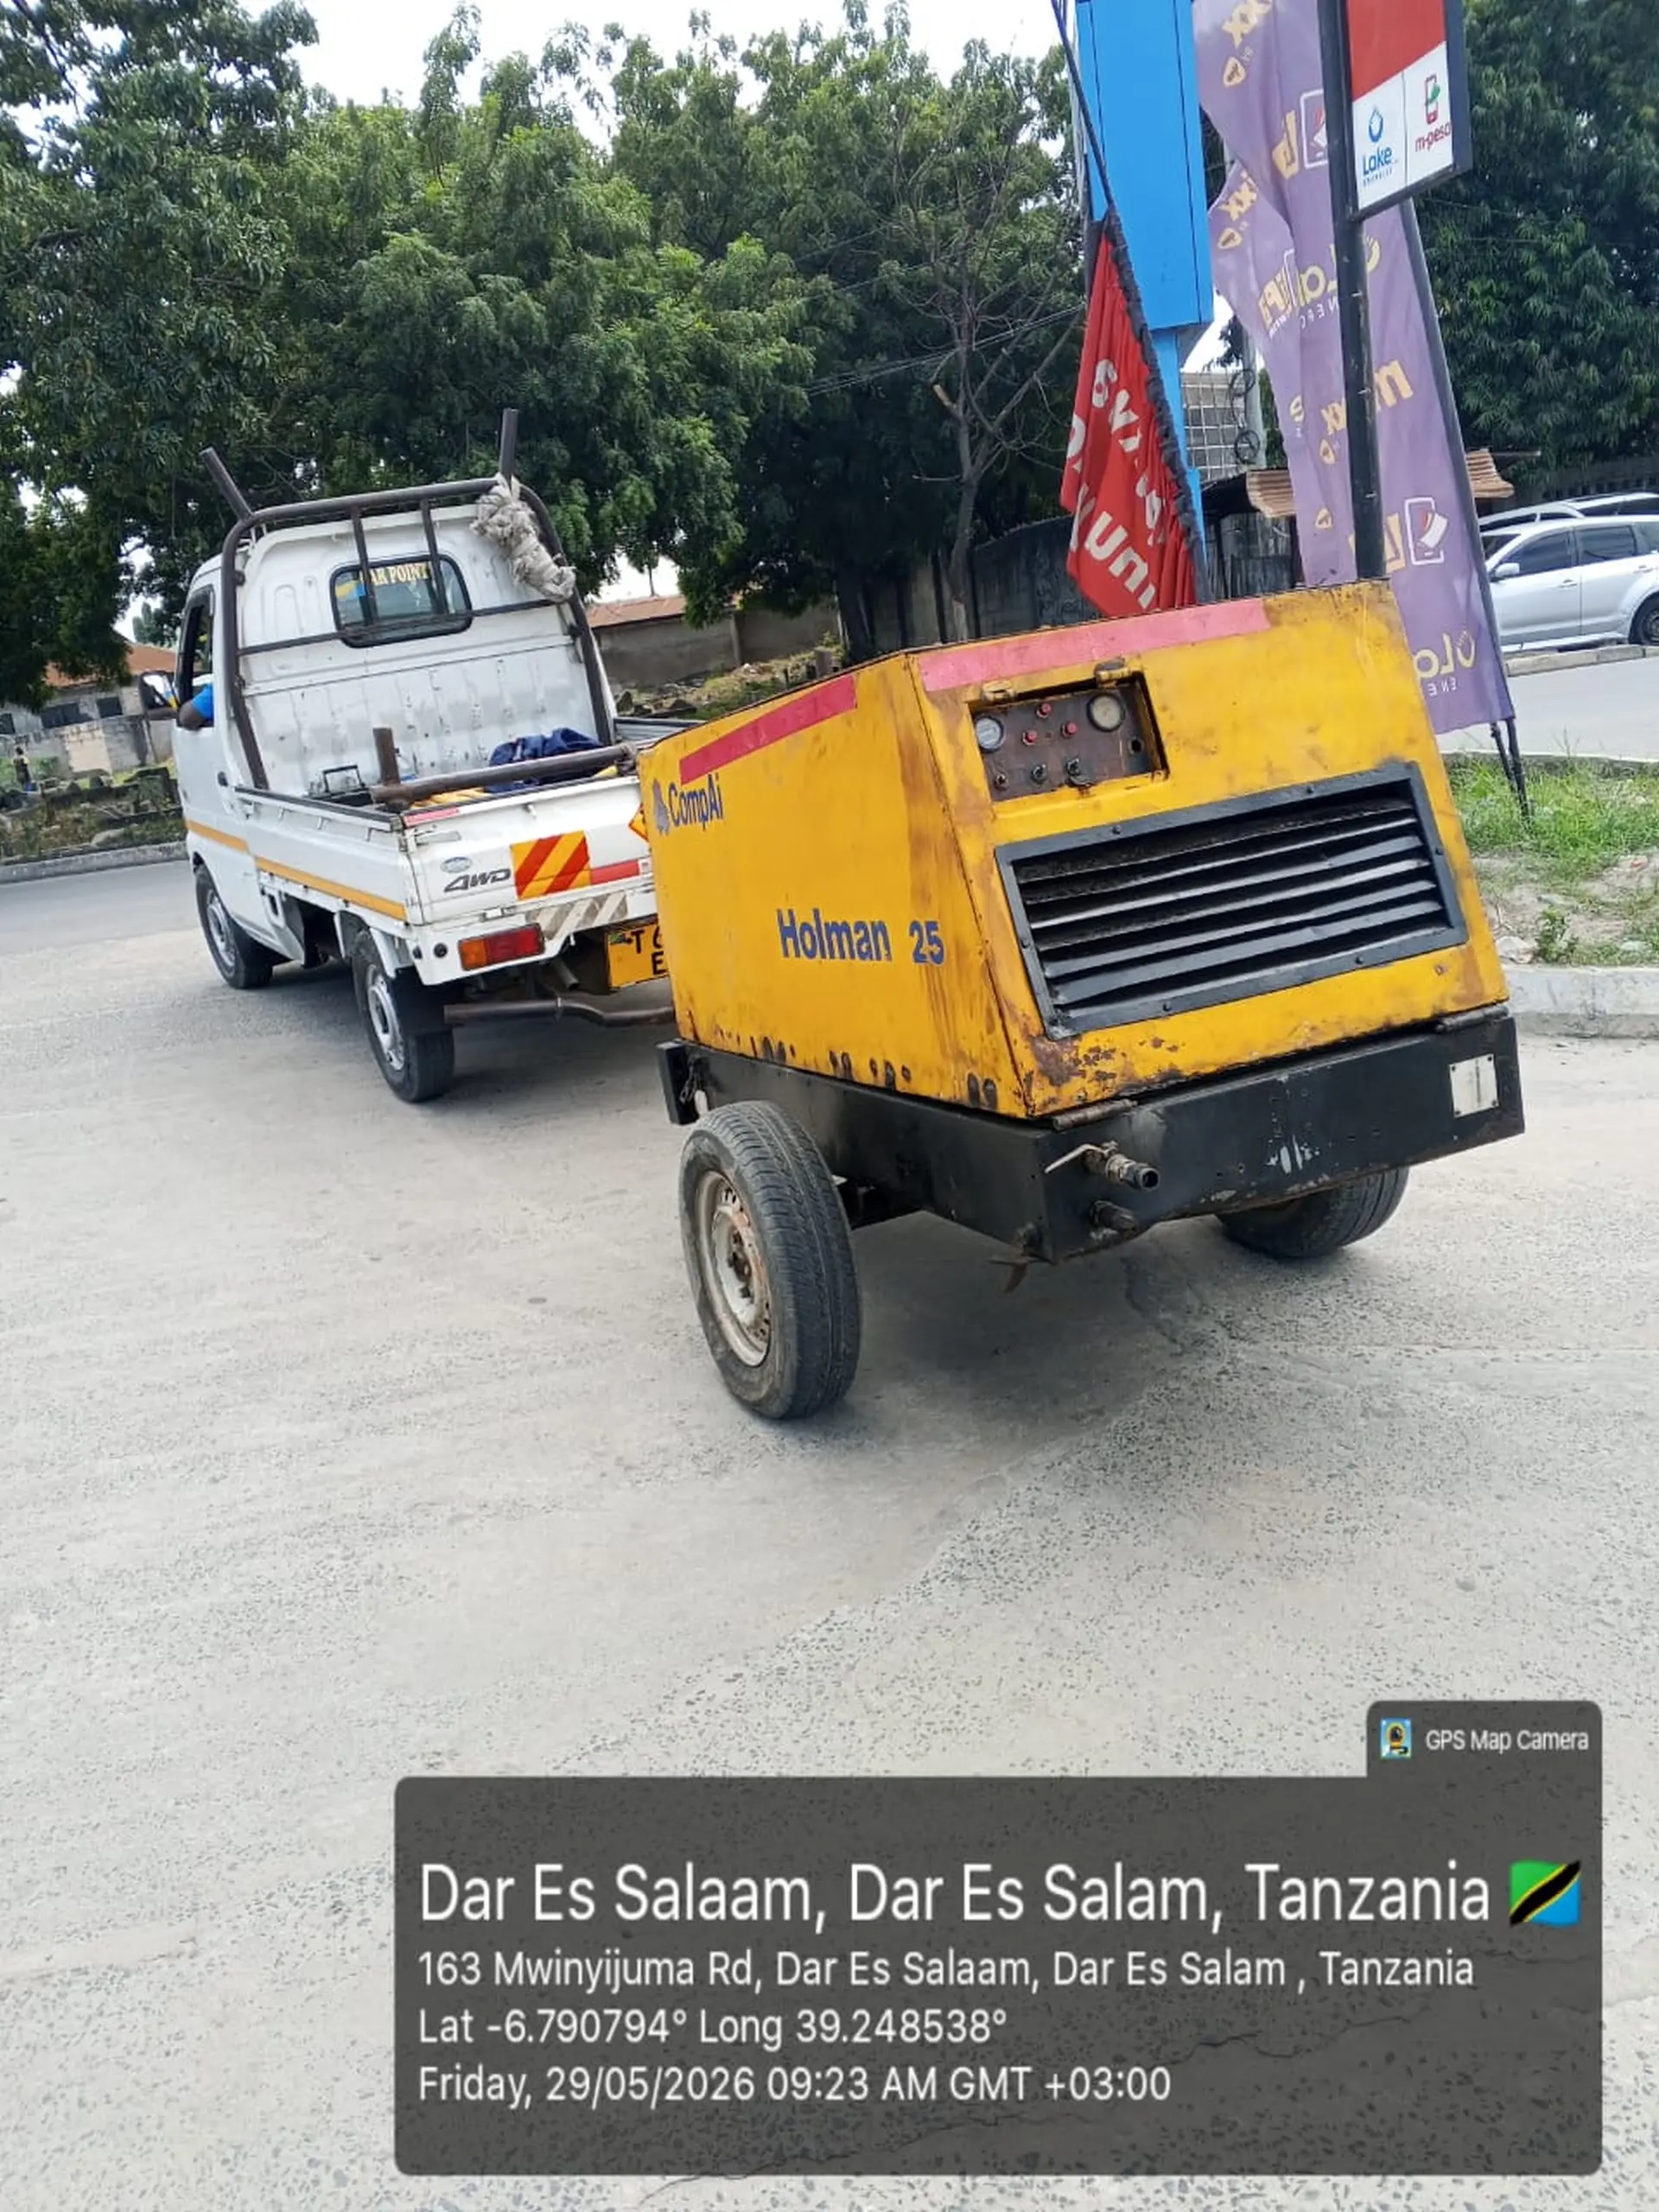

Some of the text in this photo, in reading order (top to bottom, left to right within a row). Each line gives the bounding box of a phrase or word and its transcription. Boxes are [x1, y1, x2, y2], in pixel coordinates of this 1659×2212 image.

[1363, 146, 1393, 175] Lake
[385, 561, 429, 585] POINT
[777, 907, 945, 965] Holman 25
